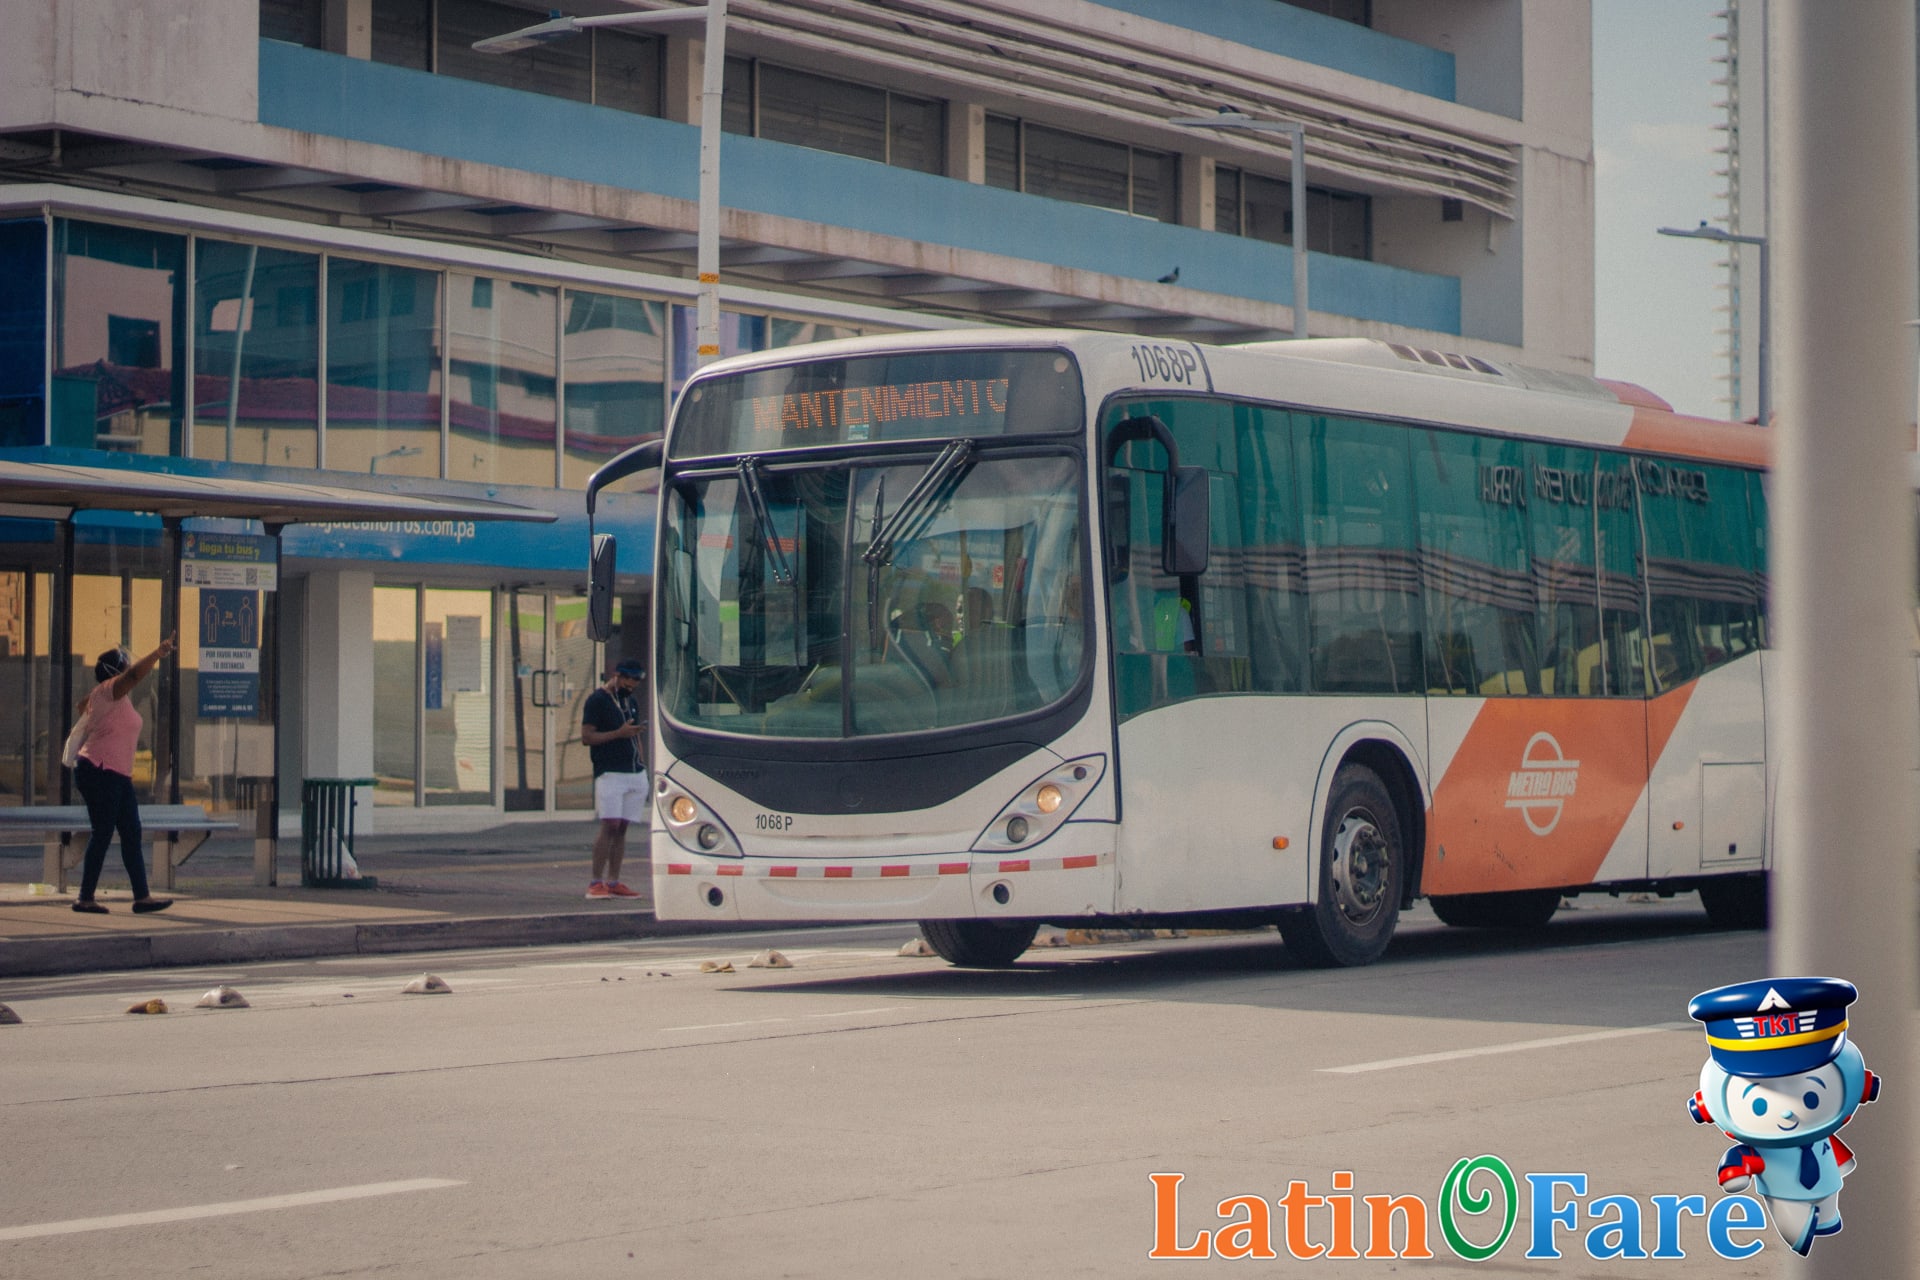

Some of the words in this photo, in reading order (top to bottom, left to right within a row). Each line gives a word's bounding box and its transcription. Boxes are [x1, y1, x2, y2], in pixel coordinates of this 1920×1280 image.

[1131, 344, 1197, 386] 1068P
[1507, 770, 1553, 797] METRO
[1551, 770, 1579, 797] BUS
[755, 813, 793, 831] 1068P
